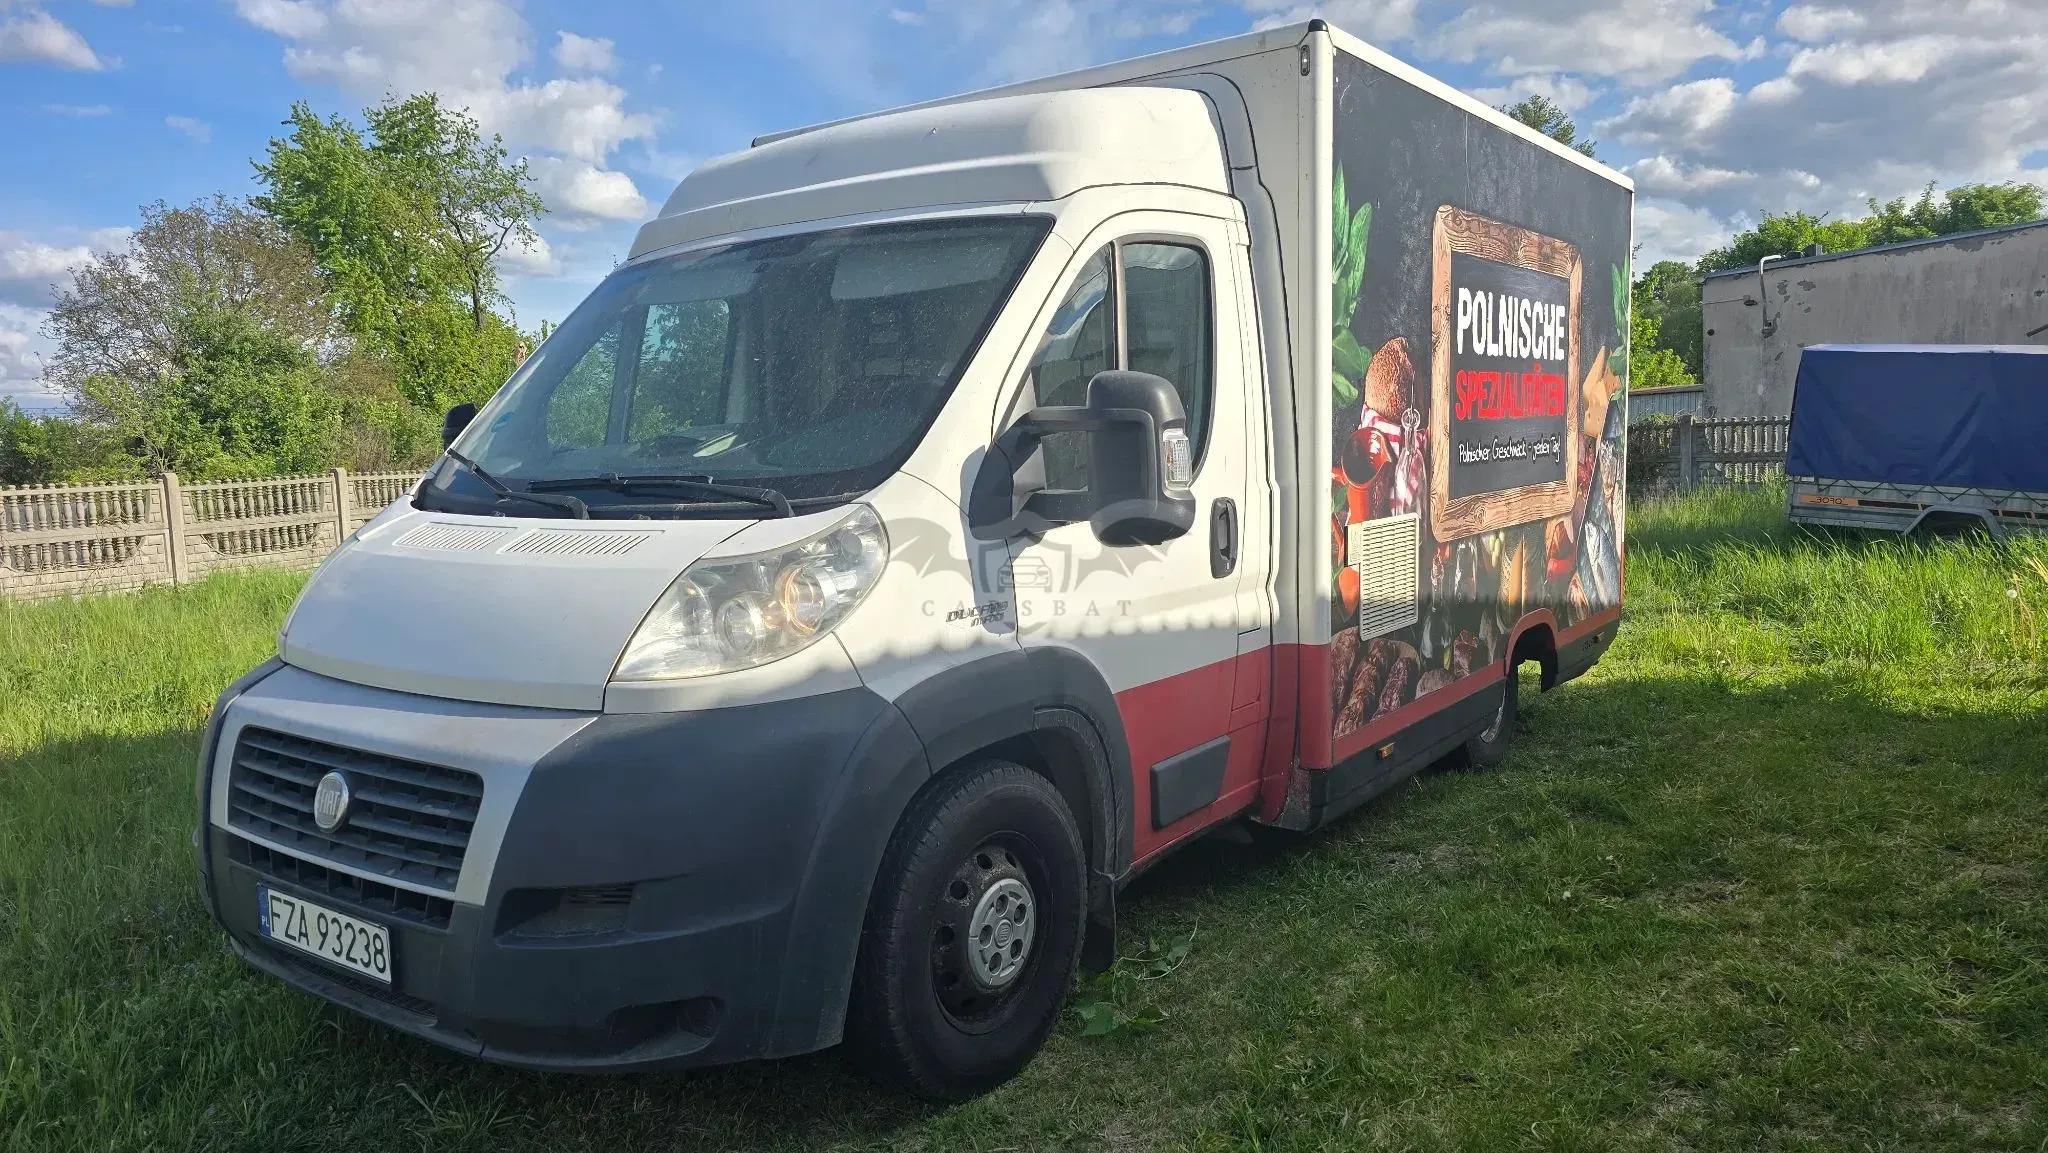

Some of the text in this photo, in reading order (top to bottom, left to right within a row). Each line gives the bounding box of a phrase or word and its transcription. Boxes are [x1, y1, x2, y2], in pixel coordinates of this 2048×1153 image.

[1457, 287, 1565, 361] POLNISCHE
[1455, 363, 1565, 420] SPEZIALITÄTEN
[1459, 441, 1490, 463] Polnischer
[1492, 438, 1527, 460] Geschmack
[1532, 438, 1550, 461] jeden
[261, 915, 270, 927] PL
[270, 894, 387, 974] FZA 93238
